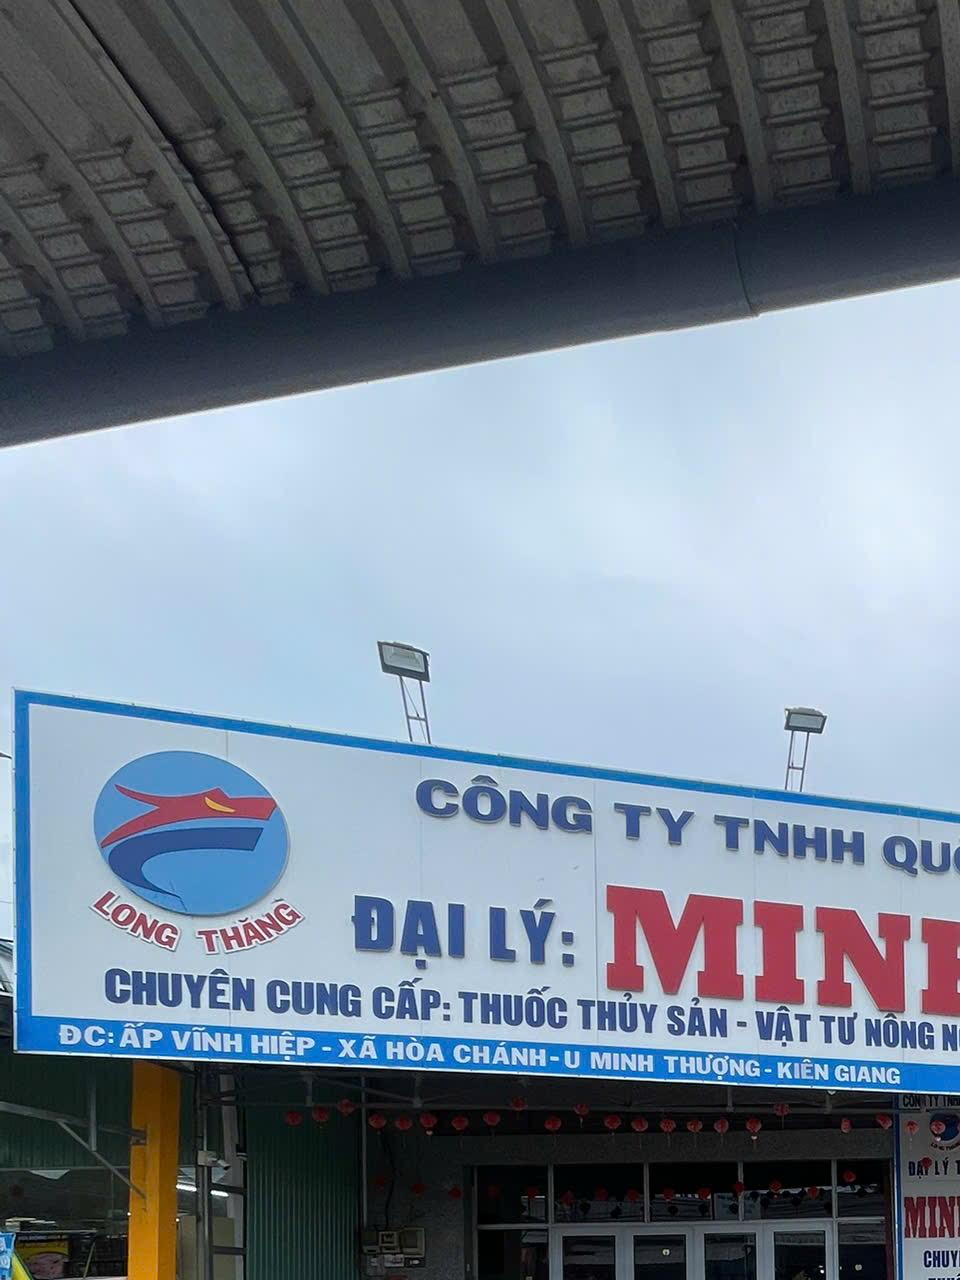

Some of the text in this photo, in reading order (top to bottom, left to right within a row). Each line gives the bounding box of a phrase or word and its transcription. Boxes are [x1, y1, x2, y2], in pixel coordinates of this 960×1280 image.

[415, 775, 593, 833] CÔNG
[614, 802, 695, 845] TY
[714, 814, 865, 866] TNHH
[91, 890, 304, 954] LONG THĂNG
[351, 894, 466, 969] ĐẠI
[489, 899, 575, 967] LÝ:
[105, 968, 254, 1013] CHUYÊN
[266, 978, 361, 1017] CUNG
[371, 977, 450, 1022] CẤP:
[458, 987, 568, 1029] THUỐC
[577, 993, 657, 1035] THỦY
[667, 998, 728, 1038] SẢN
[755, 1007, 811, 1047] VẬT
[820, 1012, 858, 1045] TƯ
[865, 1013, 935, 1051] NÔNG
[119, 1022, 163, 1049] ẤP
[171, 1026, 242, 1053] VĨNH
[251, 1031, 315, 1061] HIỆP
[338, 1035, 377, 1060] XÃ
[386, 1037, 445, 1062] HÒA
[590, 1052, 654, 1072] MINH
[777, 1059, 829, 1081] KIÊN
[834, 1064, 900, 1085] GIANG
